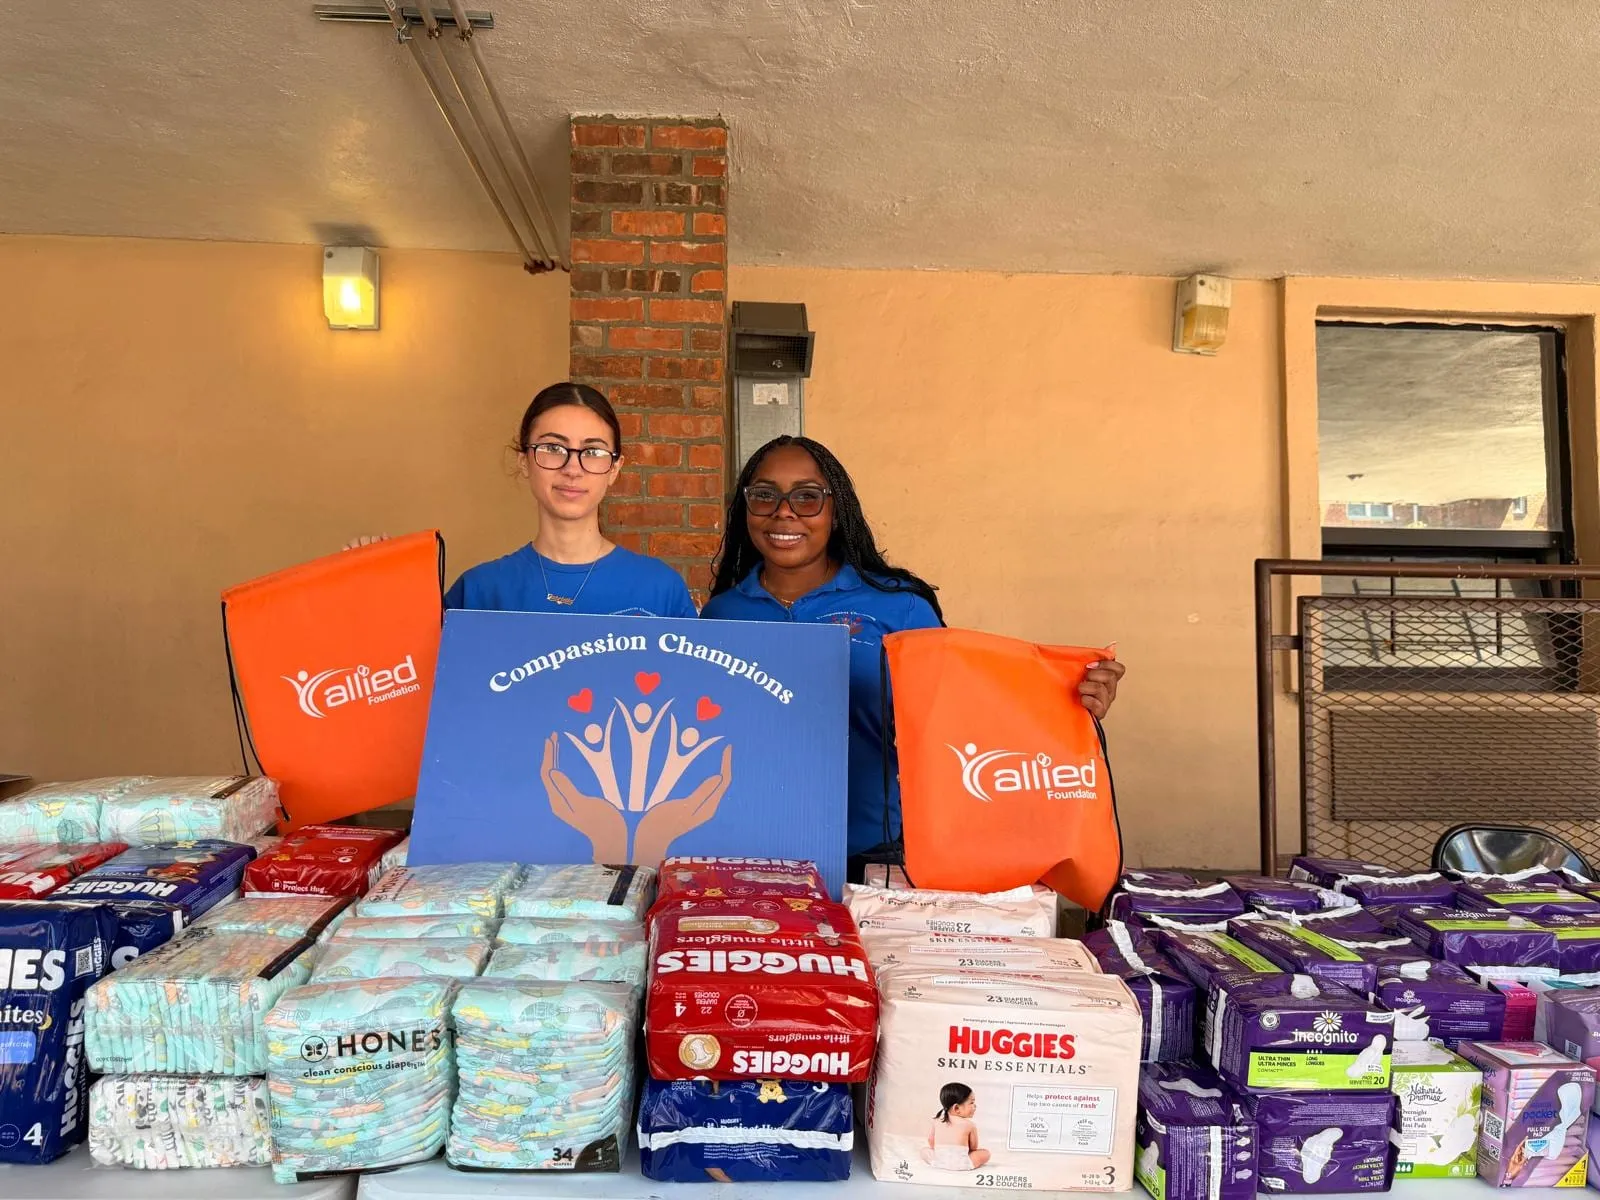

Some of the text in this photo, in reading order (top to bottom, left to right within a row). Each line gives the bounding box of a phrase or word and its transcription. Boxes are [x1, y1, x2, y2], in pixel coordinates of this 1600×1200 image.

[489, 632, 794, 705] Compassion Champions
[326, 655, 418, 708] allied
[367, 683, 420, 706] Foundation
[993, 756, 1096, 793] allied
[1047, 789, 1097, 800] Foundation
[282, 882, 309, 893] Project
[956, 922, 972, 933] 23
[675, 934, 815, 948] little snugglers
[656, 950, 869, 982] HUGGIES
[958, 958, 974, 967] 23
[693, 991, 720, 999] COUCHES
[986, 995, 1003, 1003] 23
[674, 1001, 687, 1018] 4
[700, 1005, 712, 1014] 22
[337, 1028, 458, 1058] HONEST
[823, 1033, 850, 1045] little
[948, 1025, 1076, 1060] HUGGIES
[1293, 1028, 1358, 1046] incognito
[731, 1050, 850, 1075] HUGGIES
[937, 1056, 978, 1070] SKIN
[303, 1068, 331, 1078] clean
[333, 1062, 383, 1075] conscious
[1373, 1076, 1385, 1085] 20
[1408, 1082, 1443, 1095] Nature's
[1044, 1093, 1072, 1101] protect
[1407, 1093, 1446, 1105] Promise
[1522, 1108, 1558, 1123] pocket
[23, 1122, 43, 1146] 4
[552, 1147, 573, 1161] 34
[595, 1147, 603, 1161] 1
[1103, 1165, 1115, 1185] 3
[1464, 1165, 1475, 1173] 10
[976, 1174, 994, 1187] 23
[996, 1175, 1028, 1183] DIAPERS
[996, 1181, 1033, 1189] COUCHES
